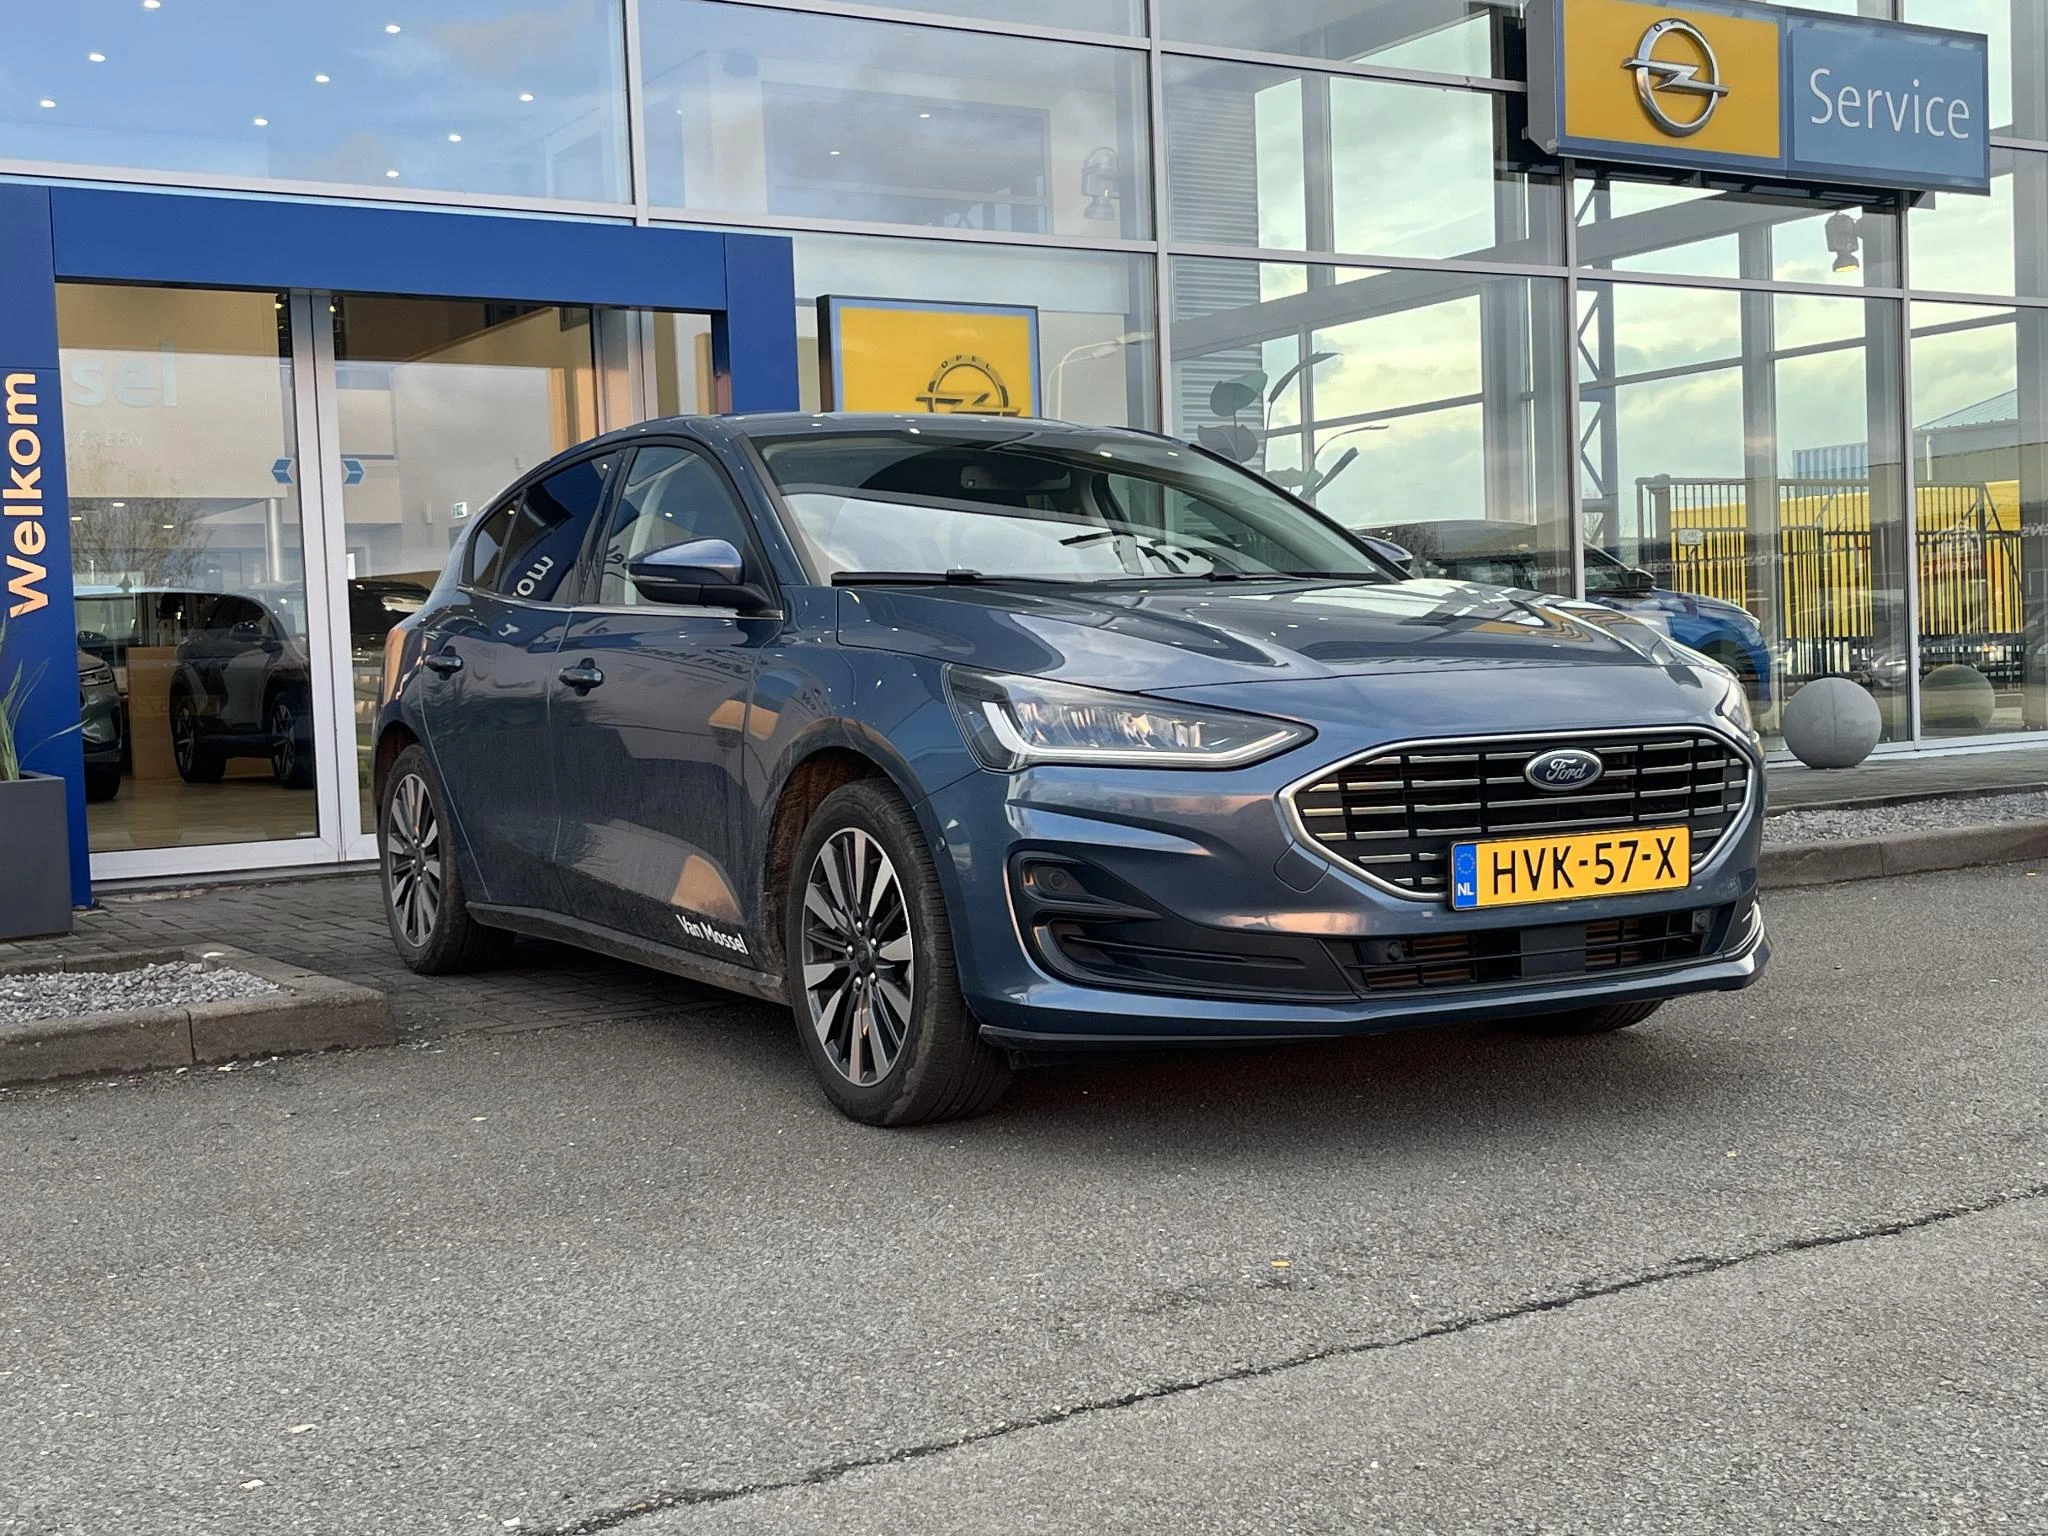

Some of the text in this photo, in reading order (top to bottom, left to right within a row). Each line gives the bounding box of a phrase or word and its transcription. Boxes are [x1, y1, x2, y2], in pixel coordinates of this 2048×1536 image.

[1808, 67, 1971, 141] Service
[941, 354, 990, 370] OPEL
[2, 371, 49, 618] Welkom
[1546, 759, 1587, 781] Ford
[1492, 836, 1676, 895] HVK-57-X
[1457, 882, 1474, 896] NL
[675, 913, 749, 955] Van Mossel
